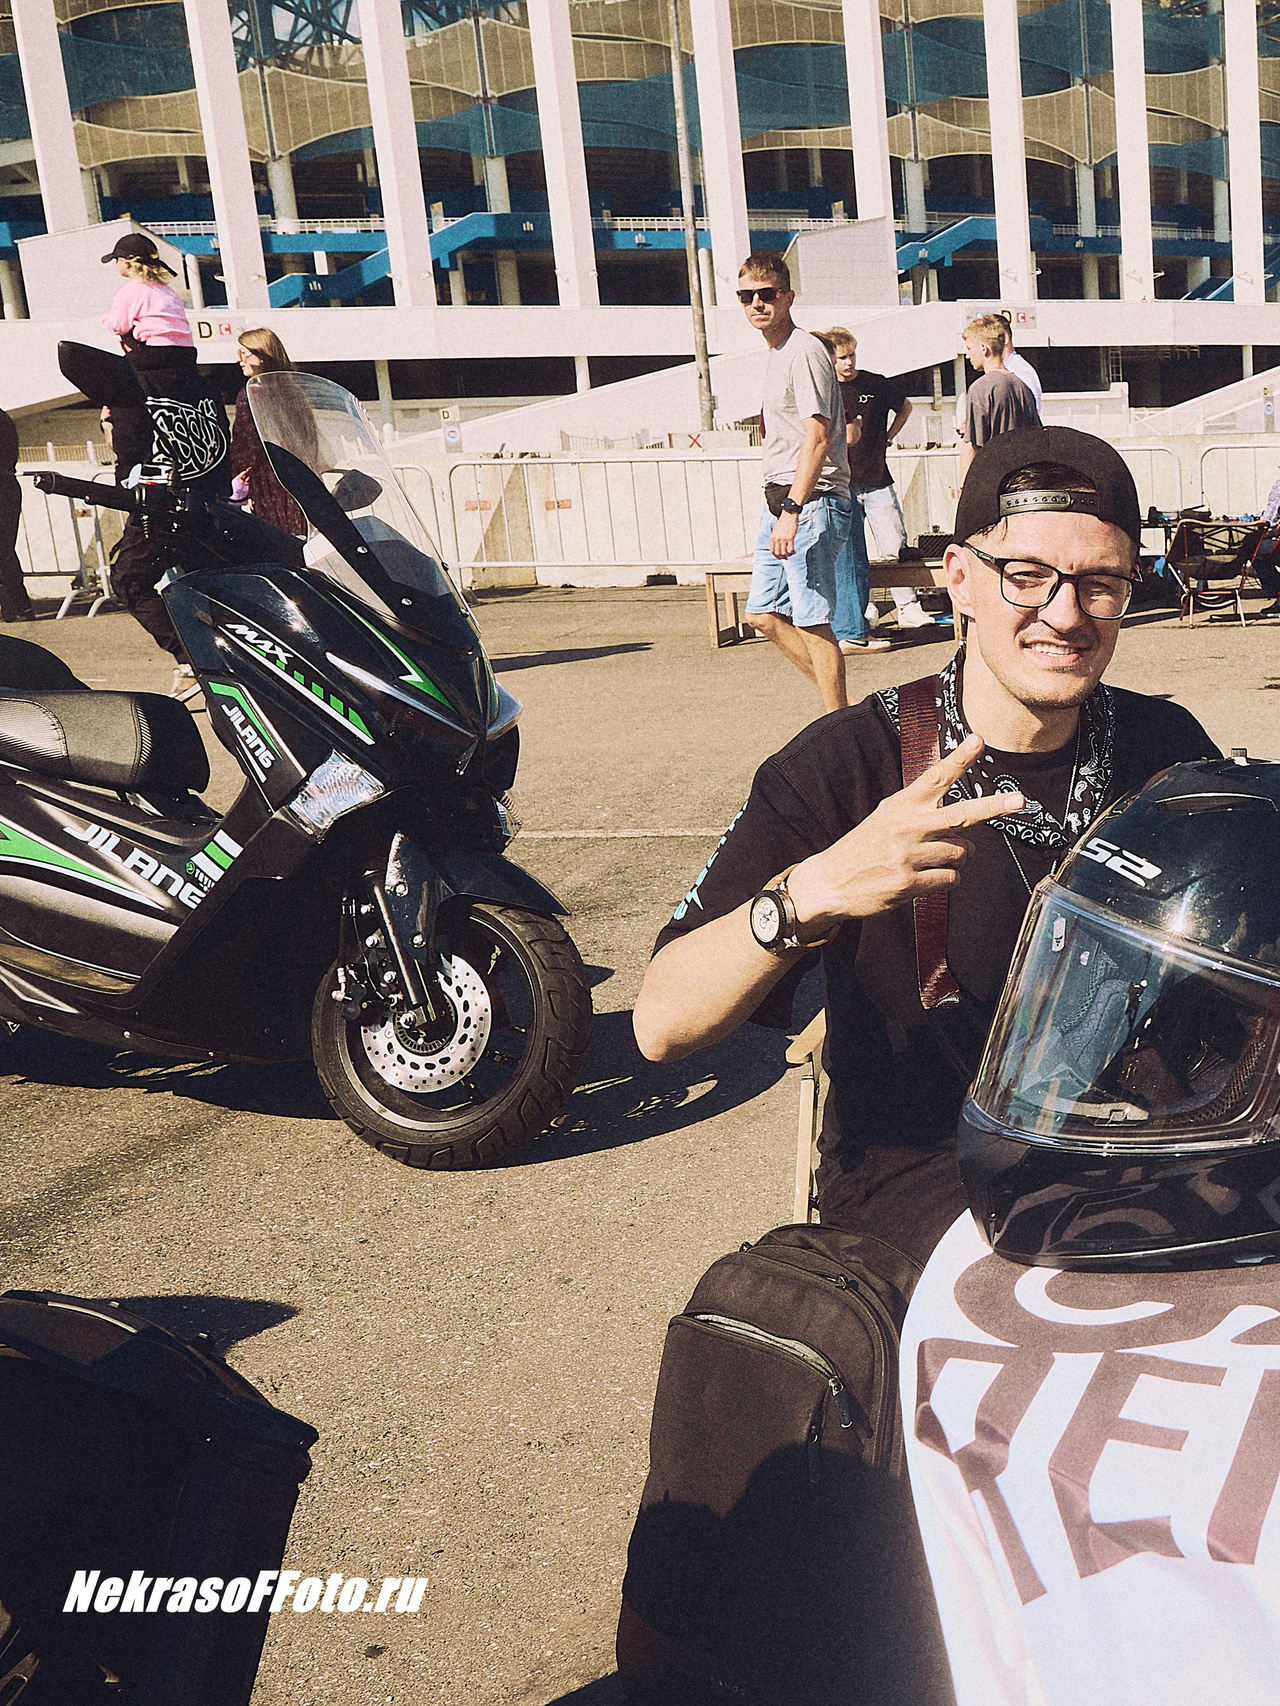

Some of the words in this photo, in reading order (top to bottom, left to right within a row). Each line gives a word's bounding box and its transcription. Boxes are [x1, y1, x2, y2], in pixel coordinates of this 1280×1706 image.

[198, 321, 212, 338] D
[442, 410, 450, 420] D
[225, 623, 294, 665] MAX
[221, 704, 275, 769] JILANG
